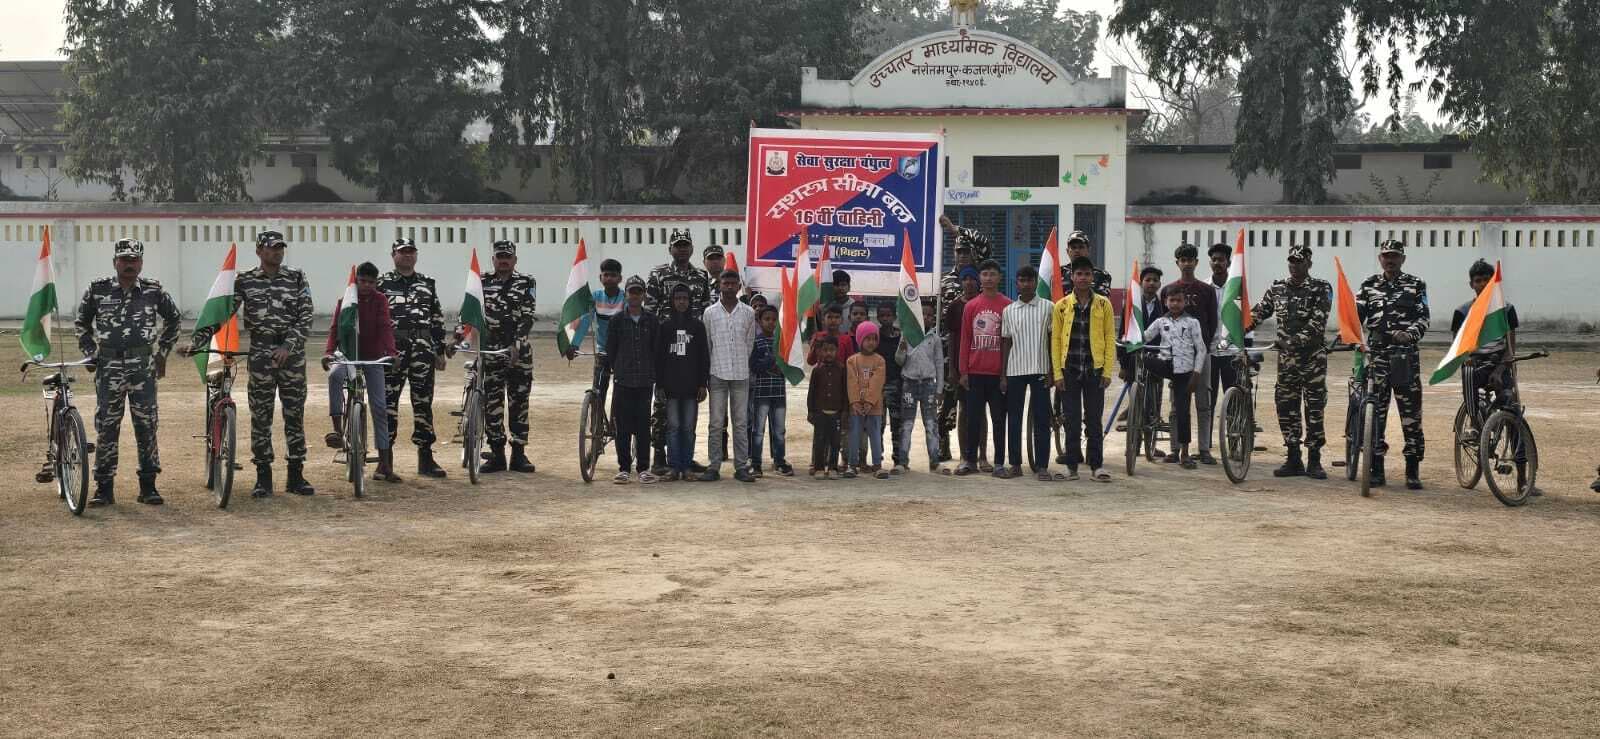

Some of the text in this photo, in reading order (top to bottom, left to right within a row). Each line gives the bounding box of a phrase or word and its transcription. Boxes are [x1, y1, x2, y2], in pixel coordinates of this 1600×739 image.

[869, 36, 1057, 88] उच्चतर माध्यमिक विद्यालय
[795, 152, 820, 167] सेवा
[824, 155, 856, 171] सुरक्षा
[766, 173, 917, 223] सशस्त्र सीमा बल
[796, 206, 885, 227] 16 वीं वाहिनी
